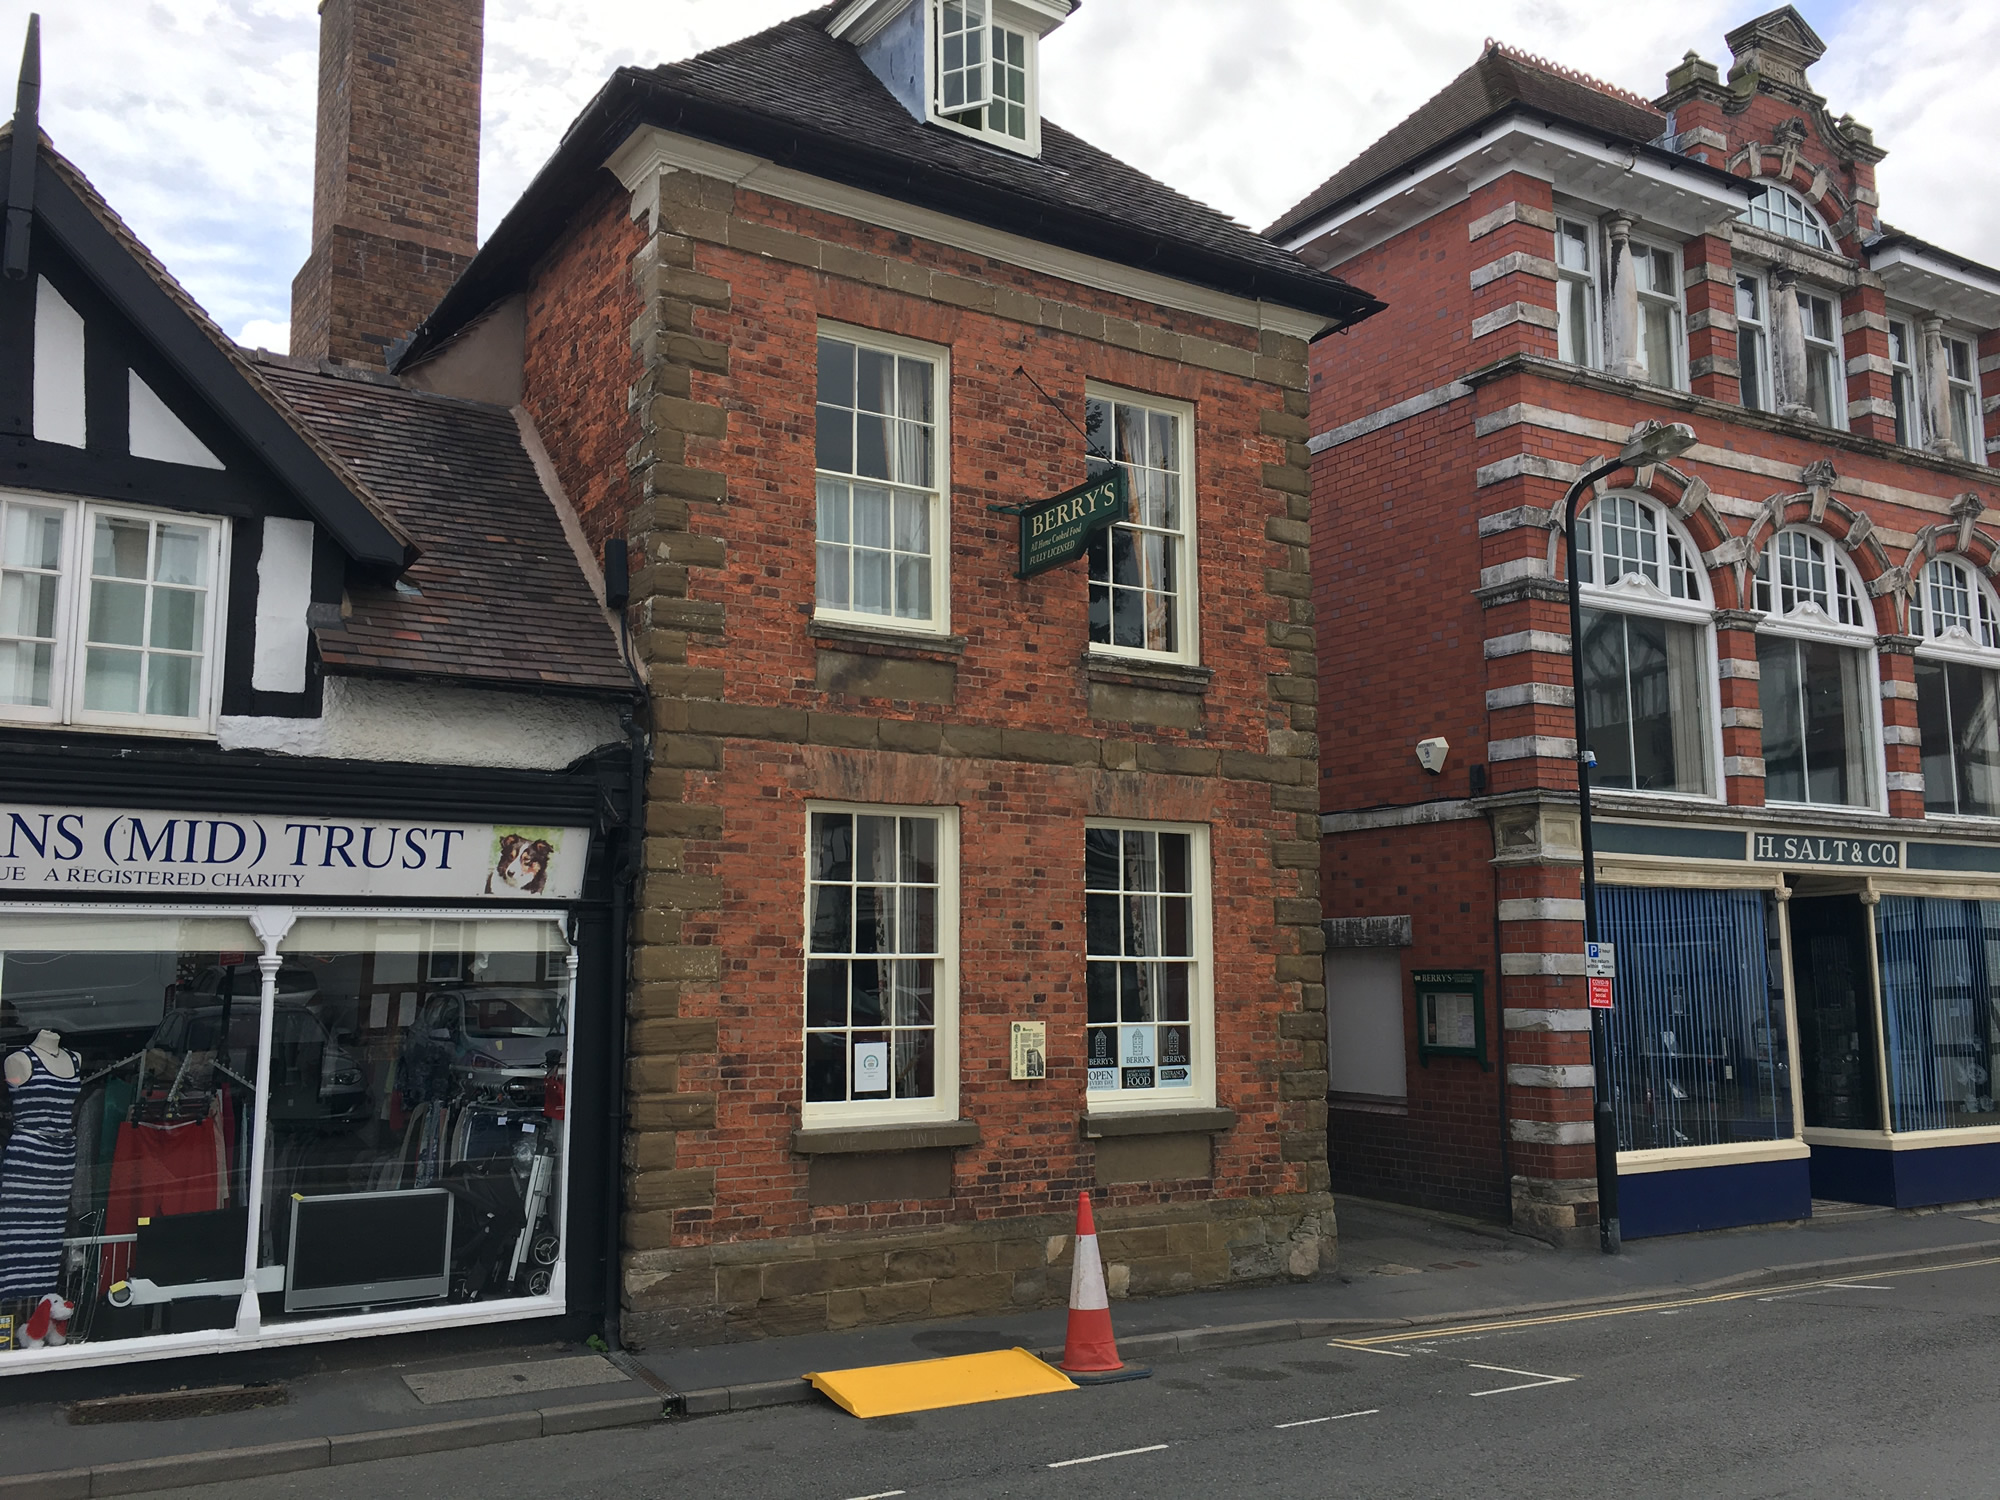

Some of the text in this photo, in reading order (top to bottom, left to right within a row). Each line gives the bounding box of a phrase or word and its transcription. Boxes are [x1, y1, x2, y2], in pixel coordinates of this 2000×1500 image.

[1031, 482, 1116, 538] BERRY'S
[1038, 538, 1051, 549] Home
[1052, 528, 1070, 543] Cooked
[1069, 522, 1082, 536] Food
[1029, 540, 1076, 566] FULLY LICENSED
[0, 812, 465, 870] NS (MID) TRUST
[1784, 837, 1848, 863] SALT
[1851, 842, 1864, 864] &
[43, 867, 60, 882] A
[66, 868, 206, 886] REGISTERED
[211, 872, 305, 888] CHARITY
[1590, 945, 1597, 957] P
[1422, 974, 1452, 983] BERRY'S
[1089, 1057, 1114, 1066] BERRY'S
[1089, 1071, 1113, 1080] OPEN
[1127, 1076, 1152, 1086] FOOD
